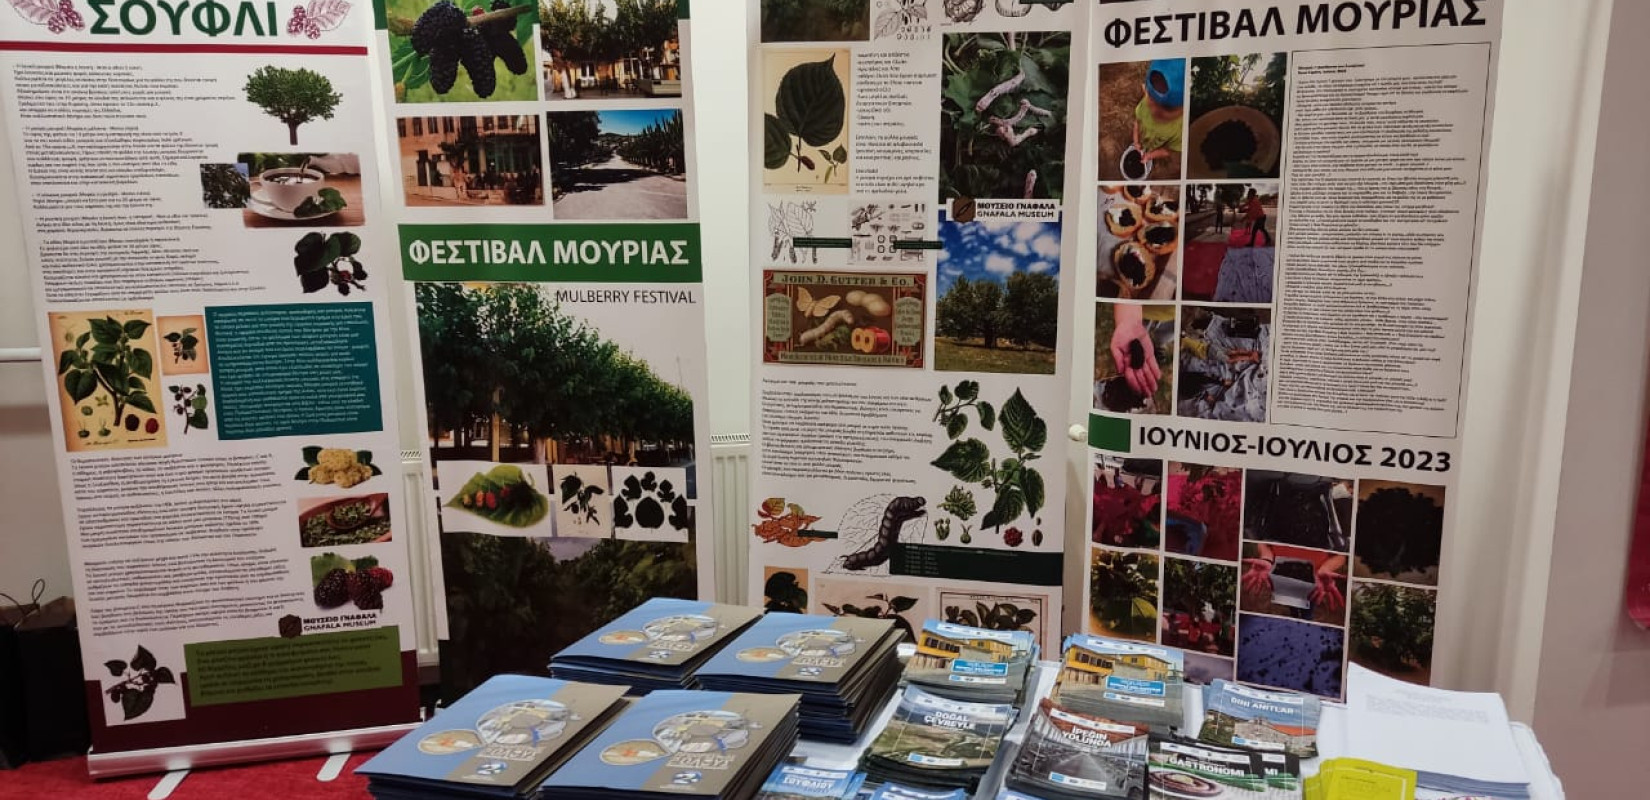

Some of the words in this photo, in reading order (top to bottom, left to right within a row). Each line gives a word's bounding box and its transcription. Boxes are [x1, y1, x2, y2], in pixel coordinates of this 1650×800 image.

[87, 0, 278, 37] ΣΟΥΦΛΙ
[1104, 7, 1284, 48] ΦΕΣΤΙΒΑΛ
[1296, 0, 1487, 35] ΜΟΥΡΙΑΣ
[976, 202, 1014, 210] ΜΟΥΣΕΙΟ
[1016, 202, 1056, 210] ΓΝΑΦΑΛΑ
[408, 239, 547, 265] ΦΕΣΤΙΒΑΛ
[553, 239, 689, 265] ΜΟΥΡΙΑΣ
[781, 274, 814, 284] JOHN
[556, 290, 629, 304] MULBERRY
[634, 290, 696, 304] FESTIVAL
[1139, 426, 1372, 465] ΙΟΥΝΙΟΣ-ΙΟΥΛΙΟΣ
[1381, 447, 1452, 473] 2023
